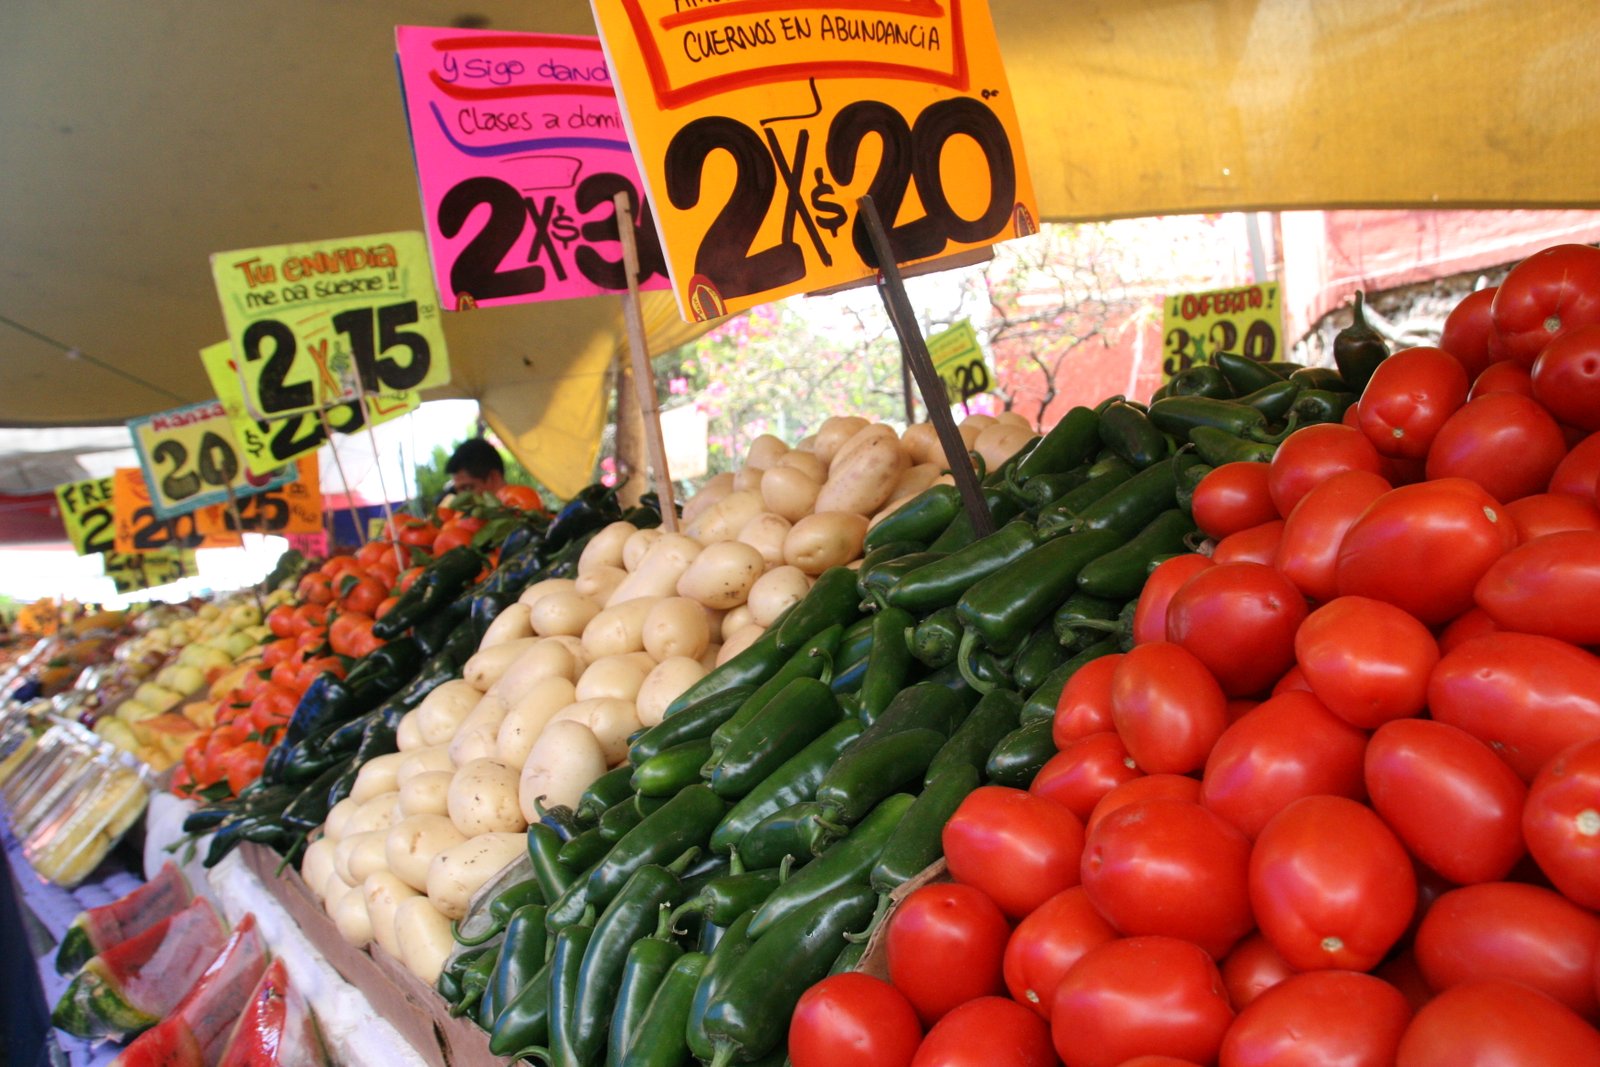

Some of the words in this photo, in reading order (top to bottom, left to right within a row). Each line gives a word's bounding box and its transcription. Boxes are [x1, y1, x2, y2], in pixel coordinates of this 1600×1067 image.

[683, 19, 776, 63] CUERNOS
[780, 16, 811, 41] EN
[543, 113, 560, 128] a
[233, 257, 276, 288] Tu
[153, 431, 238, 501] 20
